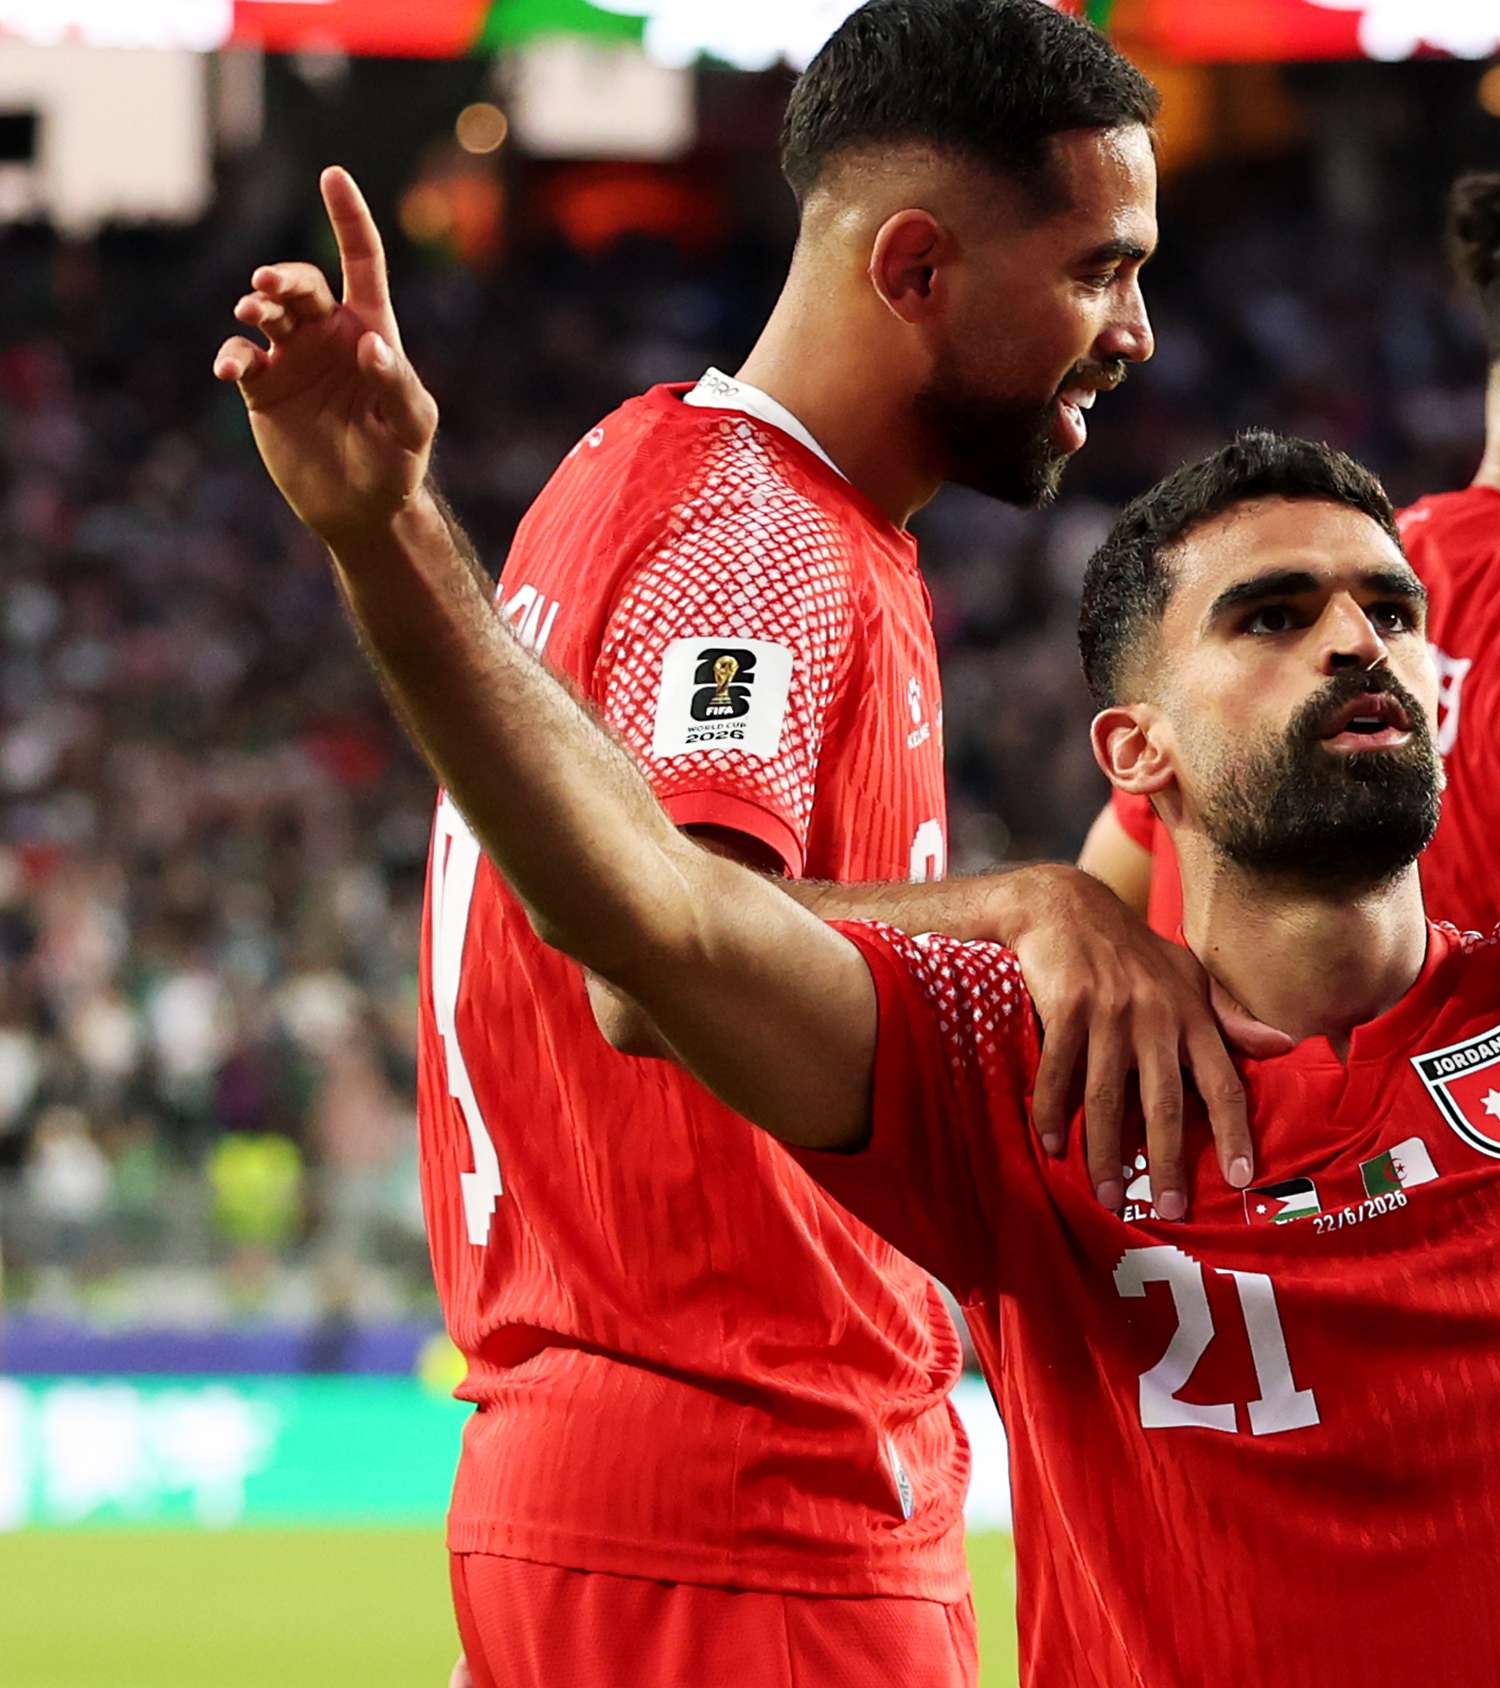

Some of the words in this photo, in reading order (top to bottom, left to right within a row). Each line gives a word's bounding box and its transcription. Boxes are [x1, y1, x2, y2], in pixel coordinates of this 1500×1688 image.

[706, 705, 734, 716] FIFA
[688, 723, 724, 732] WORLD
[726, 721, 747, 729] CUP
[685, 729, 745, 744] 2026
[1312, 1189, 1408, 1235] 22/6/2026
[1112, 1245, 1321, 1436] 21
